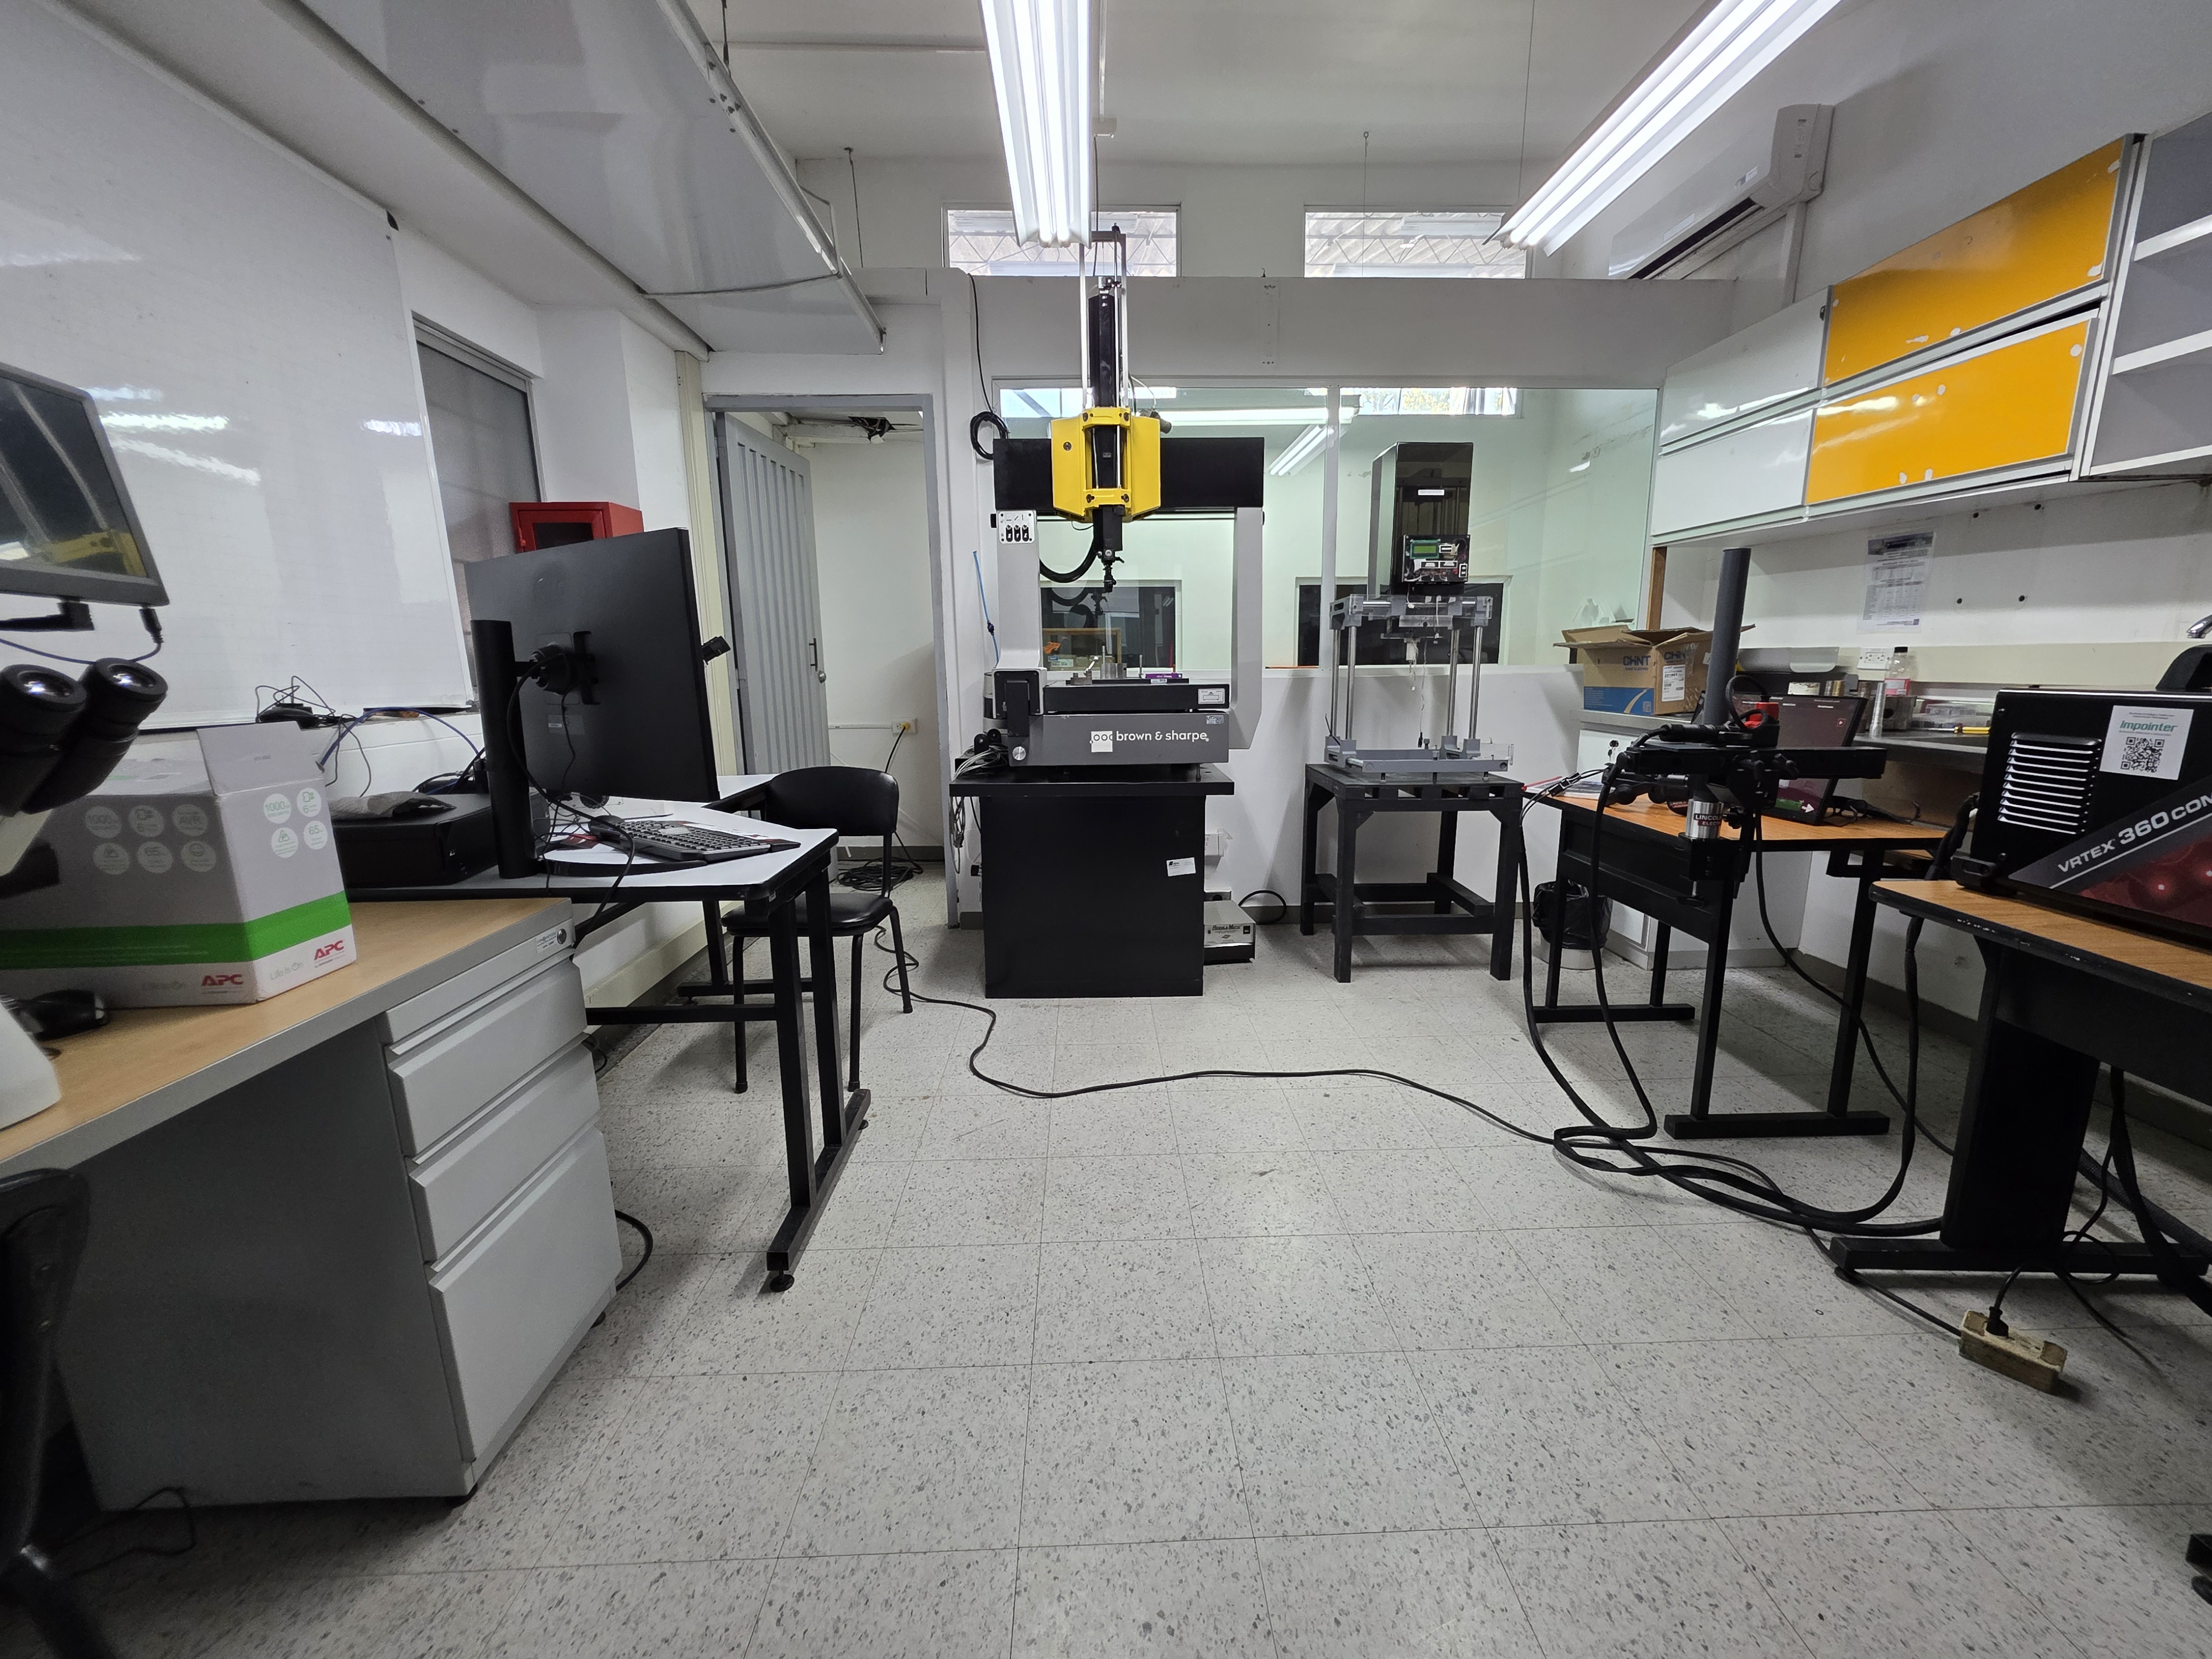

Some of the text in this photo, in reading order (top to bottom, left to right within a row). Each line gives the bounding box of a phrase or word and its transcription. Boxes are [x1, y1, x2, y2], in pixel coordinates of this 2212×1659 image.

[2120, 720, 2178, 732] Impointer
[1116, 730, 1207, 742] brown & sharpe
[2058, 839, 2116, 872] VRTEX
[2118, 811, 2169, 844] 360
[314, 940, 344, 961] APC
[270, 968, 284, 980] Life
[291, 962, 304, 971] On
[201, 974, 244, 987] APC
